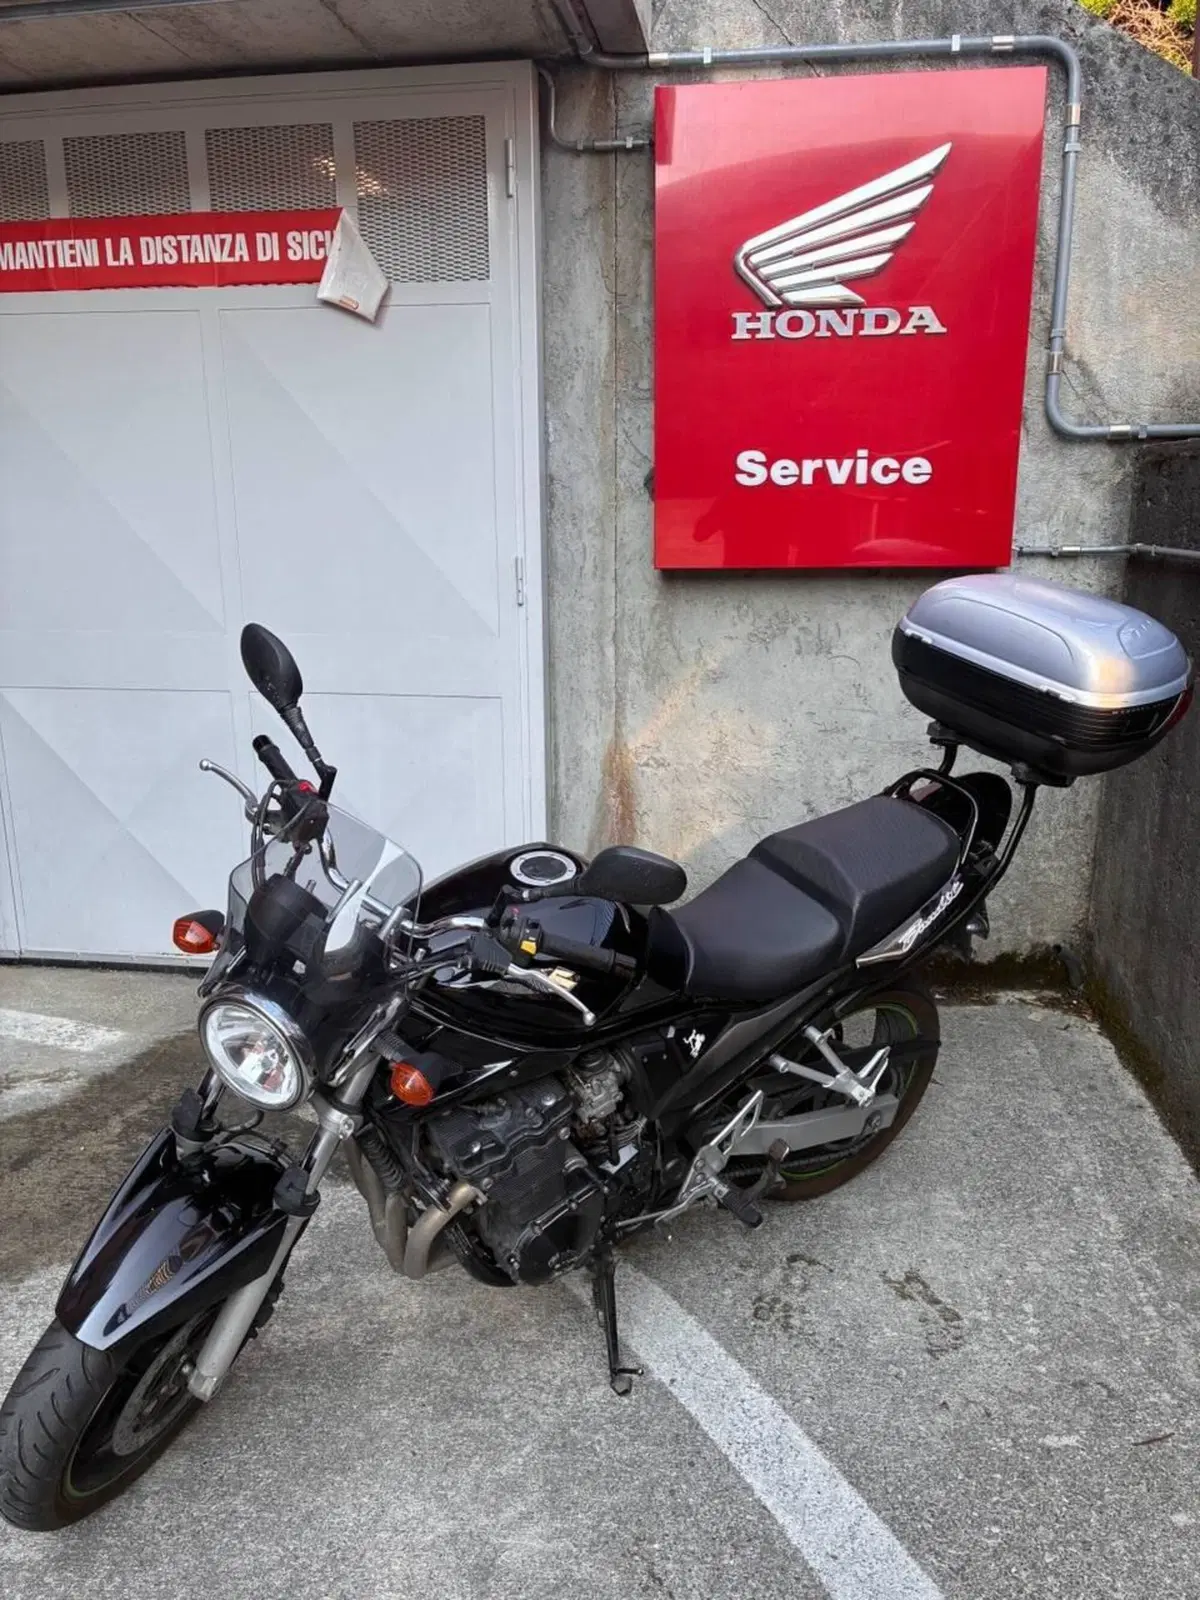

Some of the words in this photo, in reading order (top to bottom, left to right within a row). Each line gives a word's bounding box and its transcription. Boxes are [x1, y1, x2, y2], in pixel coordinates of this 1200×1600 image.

[0, 239, 99, 270] MANTIENI
[106, 237, 134, 266] LA
[141, 233, 249, 264] DISTANZA
[256, 232, 280, 261] DI
[731, 306, 948, 340] HONDA
[735, 449, 933, 487] Service
